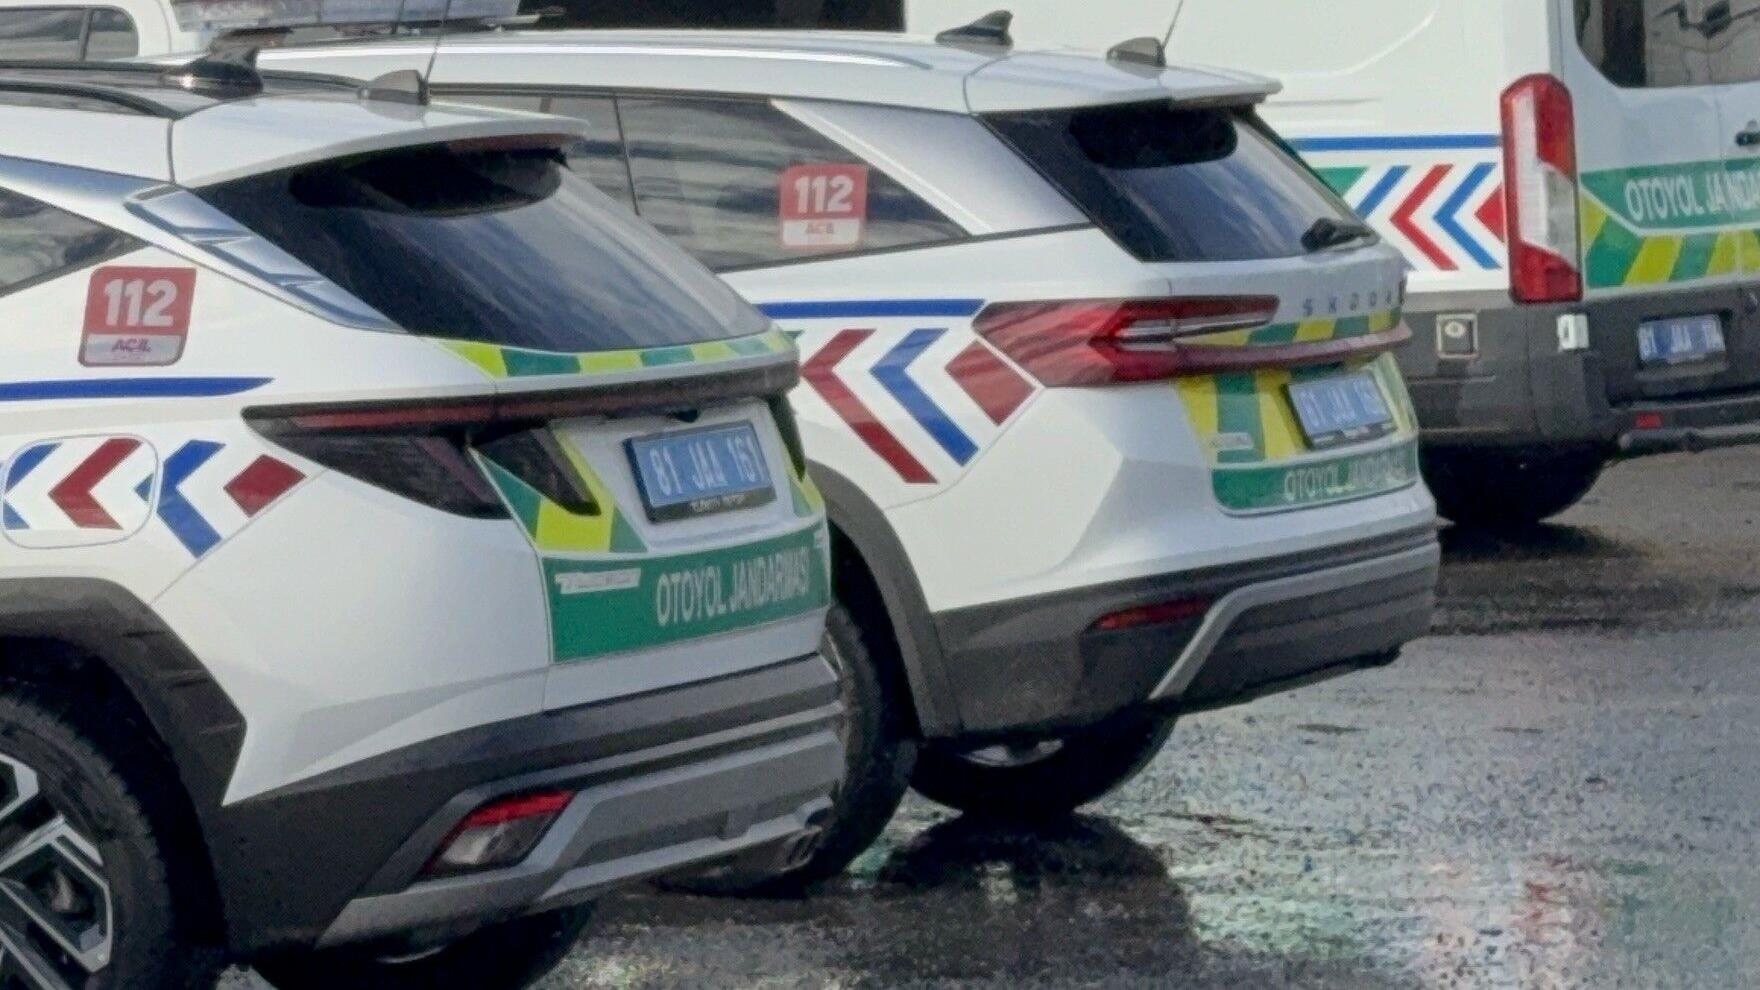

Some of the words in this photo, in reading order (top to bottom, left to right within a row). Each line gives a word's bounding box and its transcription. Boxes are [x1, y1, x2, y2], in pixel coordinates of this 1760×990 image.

[795, 175, 854, 213] 112
[1624, 175, 1704, 222] OTOYOL
[104, 278, 177, 327] 112
[650, 446, 683, 496] 81
[688, 440, 729, 491] JAA
[657, 566, 727, 627] OTOYOL
